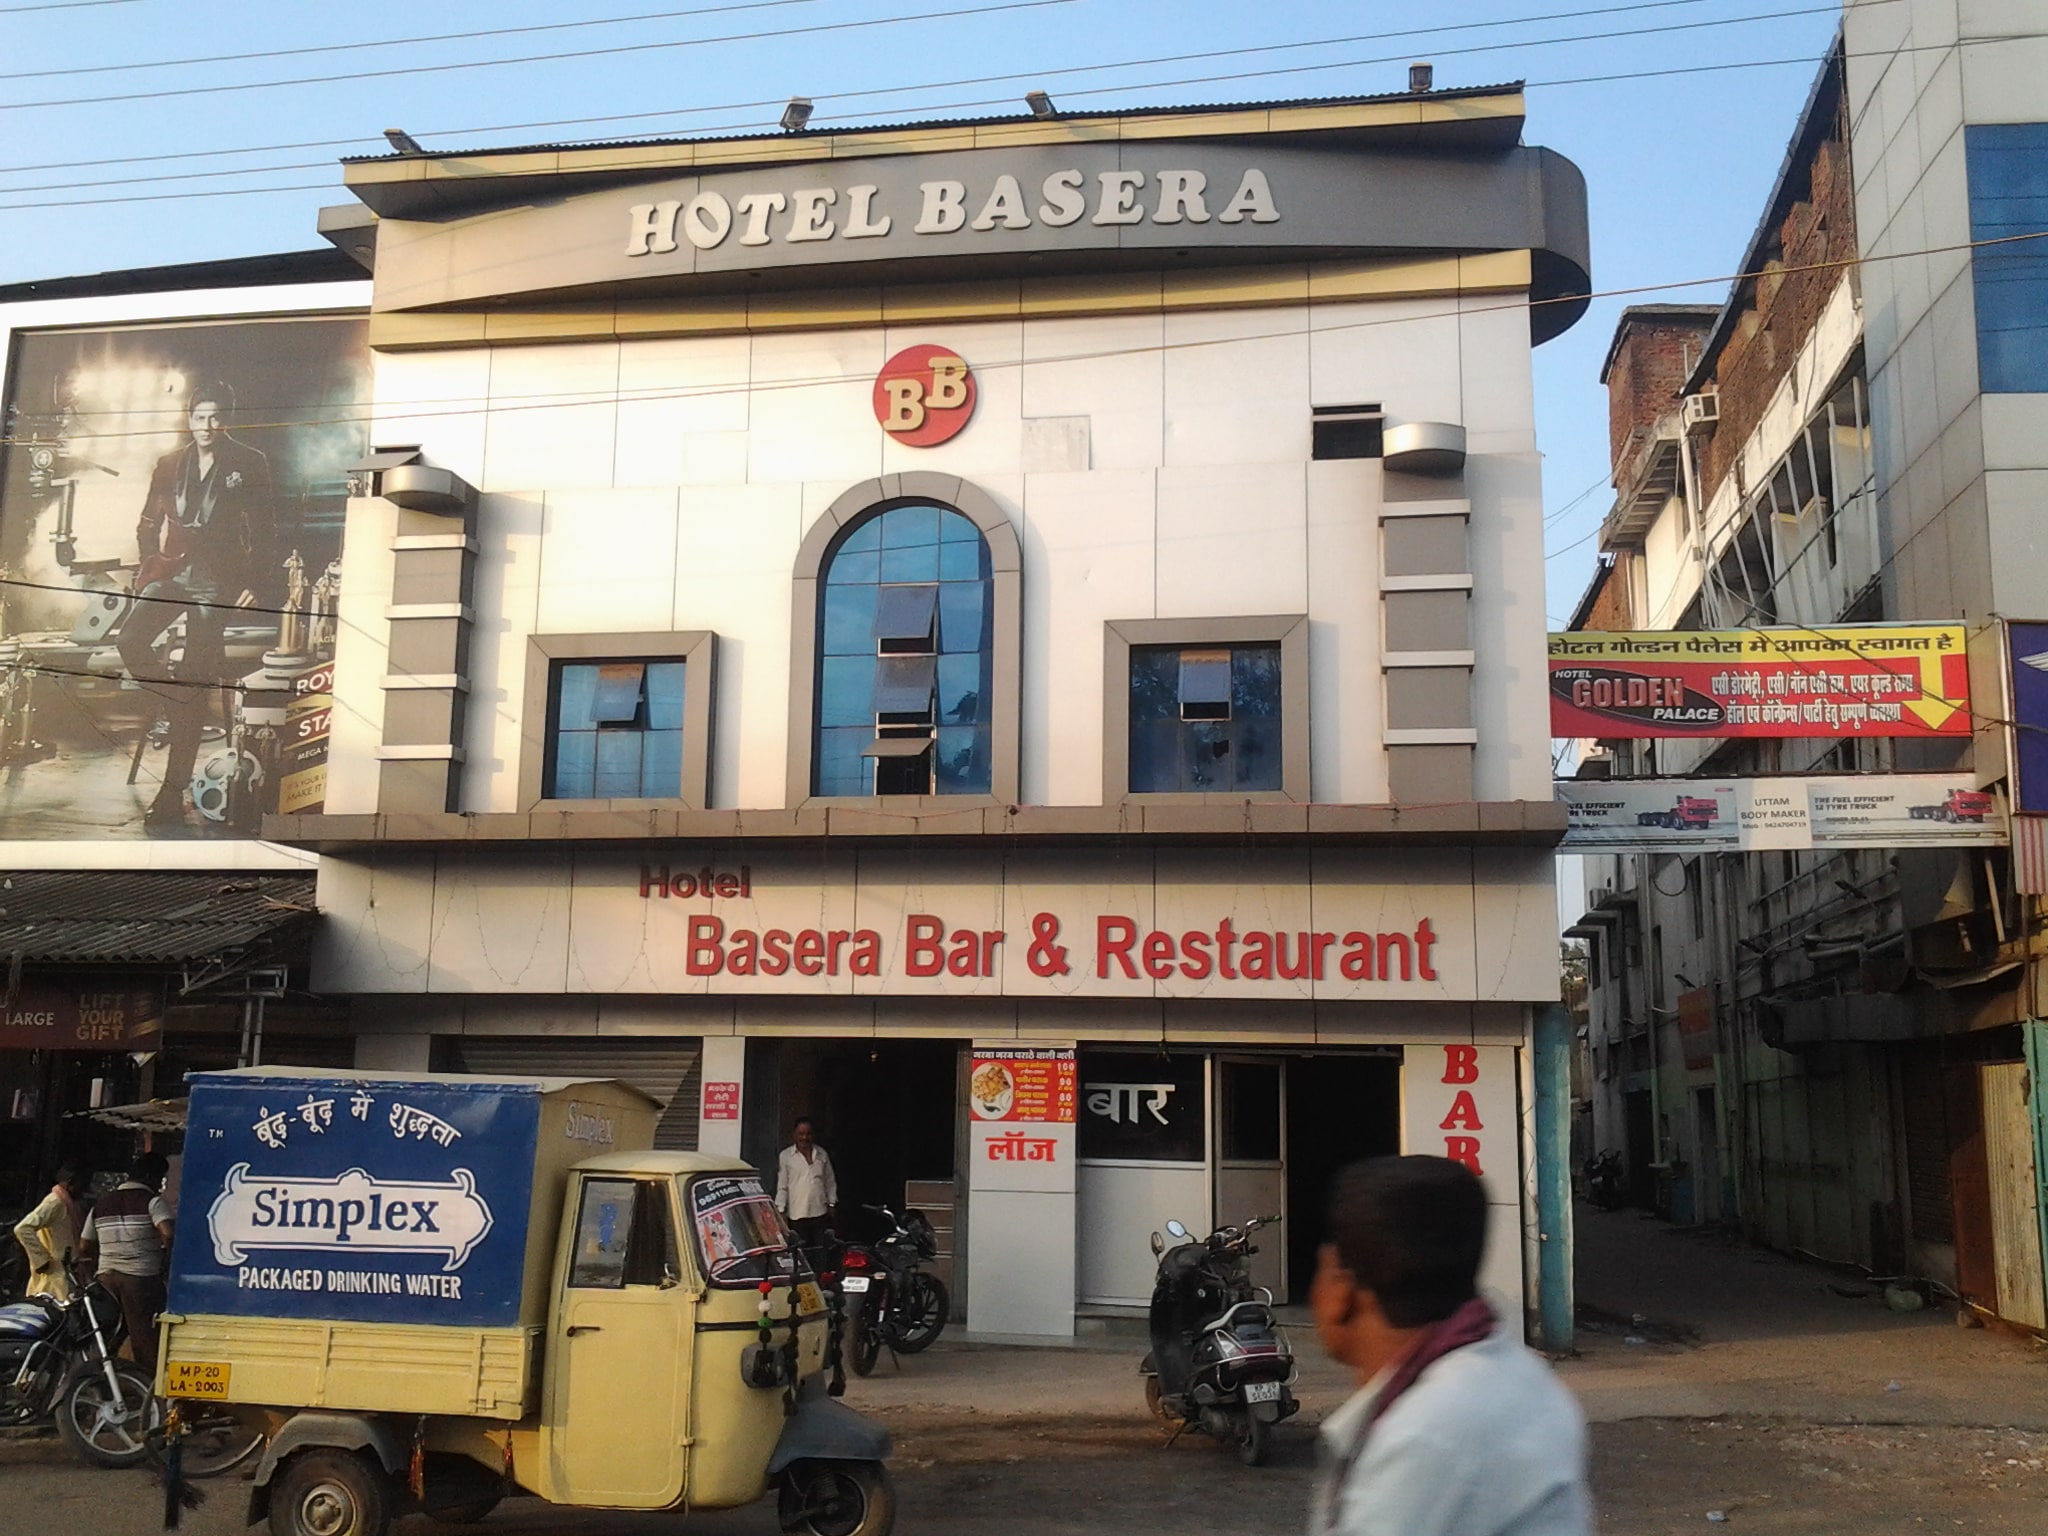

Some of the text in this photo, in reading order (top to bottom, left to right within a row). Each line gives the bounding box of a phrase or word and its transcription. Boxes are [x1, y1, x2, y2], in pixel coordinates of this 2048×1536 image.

[626, 168, 1282, 257] HOTEL BASERA
[1610, 637, 1681, 654] गोल्डन
[1685, 636, 1743, 654] पैलेस
[1774, 639, 1852, 653] आपका
[1856, 638, 1932, 651] स्वागत
[1935, 633, 1956, 650] है
[1555, 670, 1593, 679] HOTEL
[1572, 678, 1685, 708] GOLDEN
[1652, 708, 1720, 721] PALACE
[1585, 802, 1626, 810] EFFICIENT
[1754, 798, 1790, 807] UTTAM
[1853, 795, 1895, 803] EFFICIENT
[1582, 809, 1609, 817] TRUCK
[1740, 810, 1807, 820] BODY MAKER
[639, 864, 751, 899] Hotel
[685, 911, 1438, 982] Basera Bar & Restaurant
[80, 993, 126, 1009] LIFT
[5, 1012, 55, 1026] LARGE
[78, 1009, 125, 1026] YOUR
[76, 1025, 125, 1041] GIFT
[1084, 1082, 1176, 1126] बार
[1439, 1044, 1484, 1176] BAR
[350, 1089, 376, 1122] में
[389, 1102, 463, 1148] शुद्धता
[208, 1128, 225, 1139] TM
[985, 1131, 1058, 1163] लॉज
[251, 1187, 441, 1243] Simplex
[238, 1266, 463, 1300] PACKAGED DRINKING WATER
